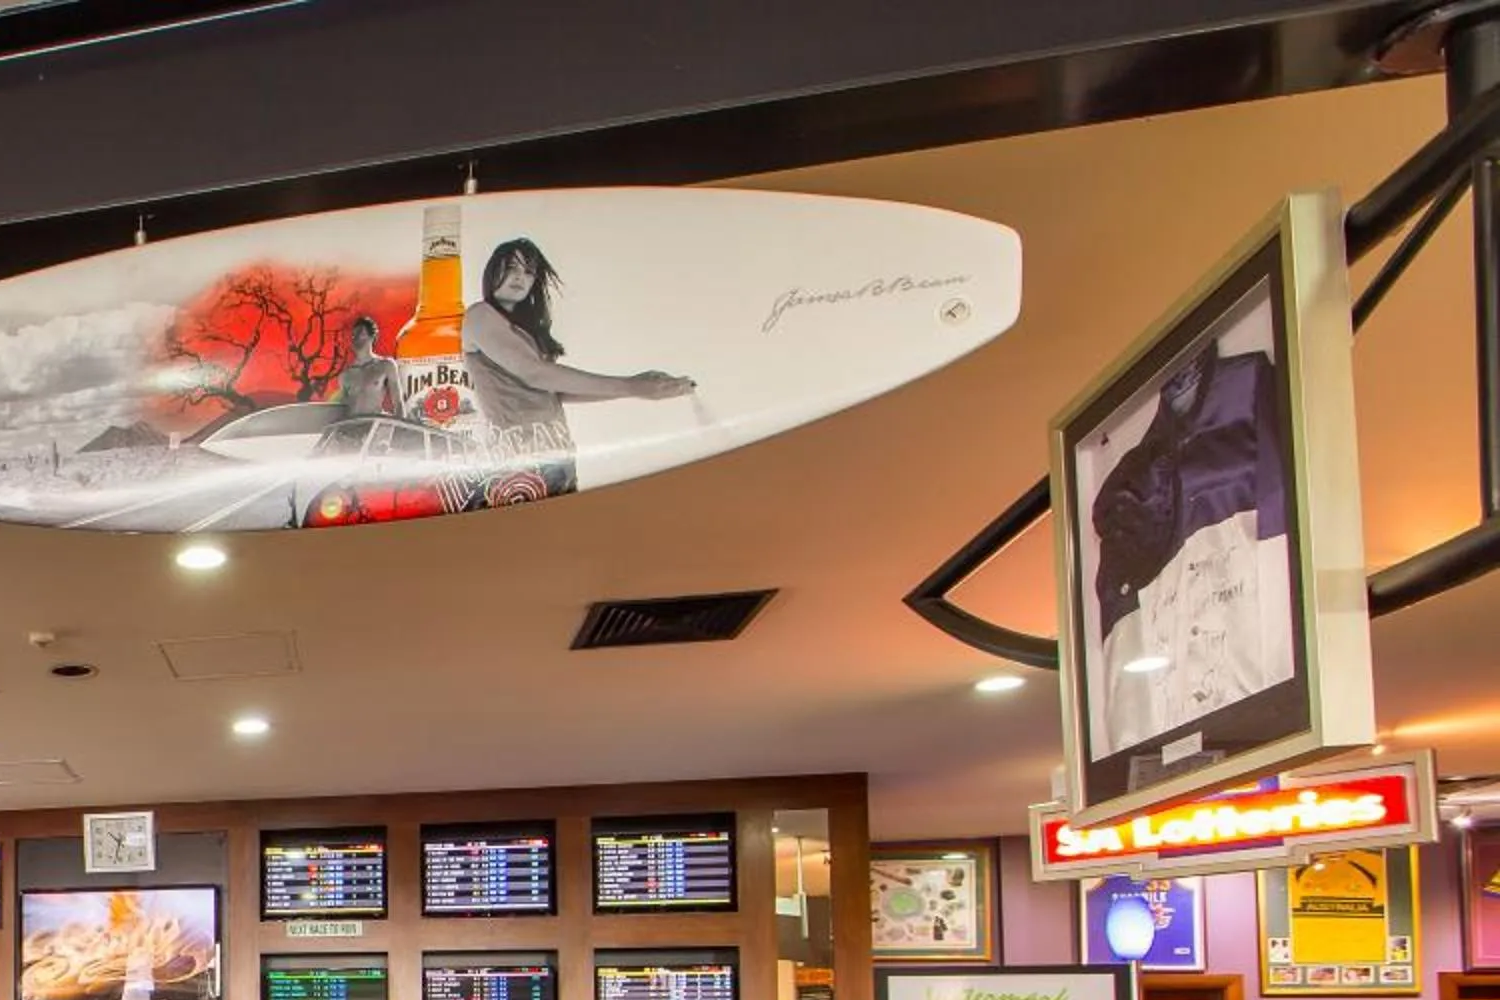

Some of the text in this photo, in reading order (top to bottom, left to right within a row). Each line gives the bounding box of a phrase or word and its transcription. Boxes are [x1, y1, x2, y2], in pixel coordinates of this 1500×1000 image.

[404, 363, 474, 401] JIM BEA
[1133, 791, 1388, 850] Lotteries
